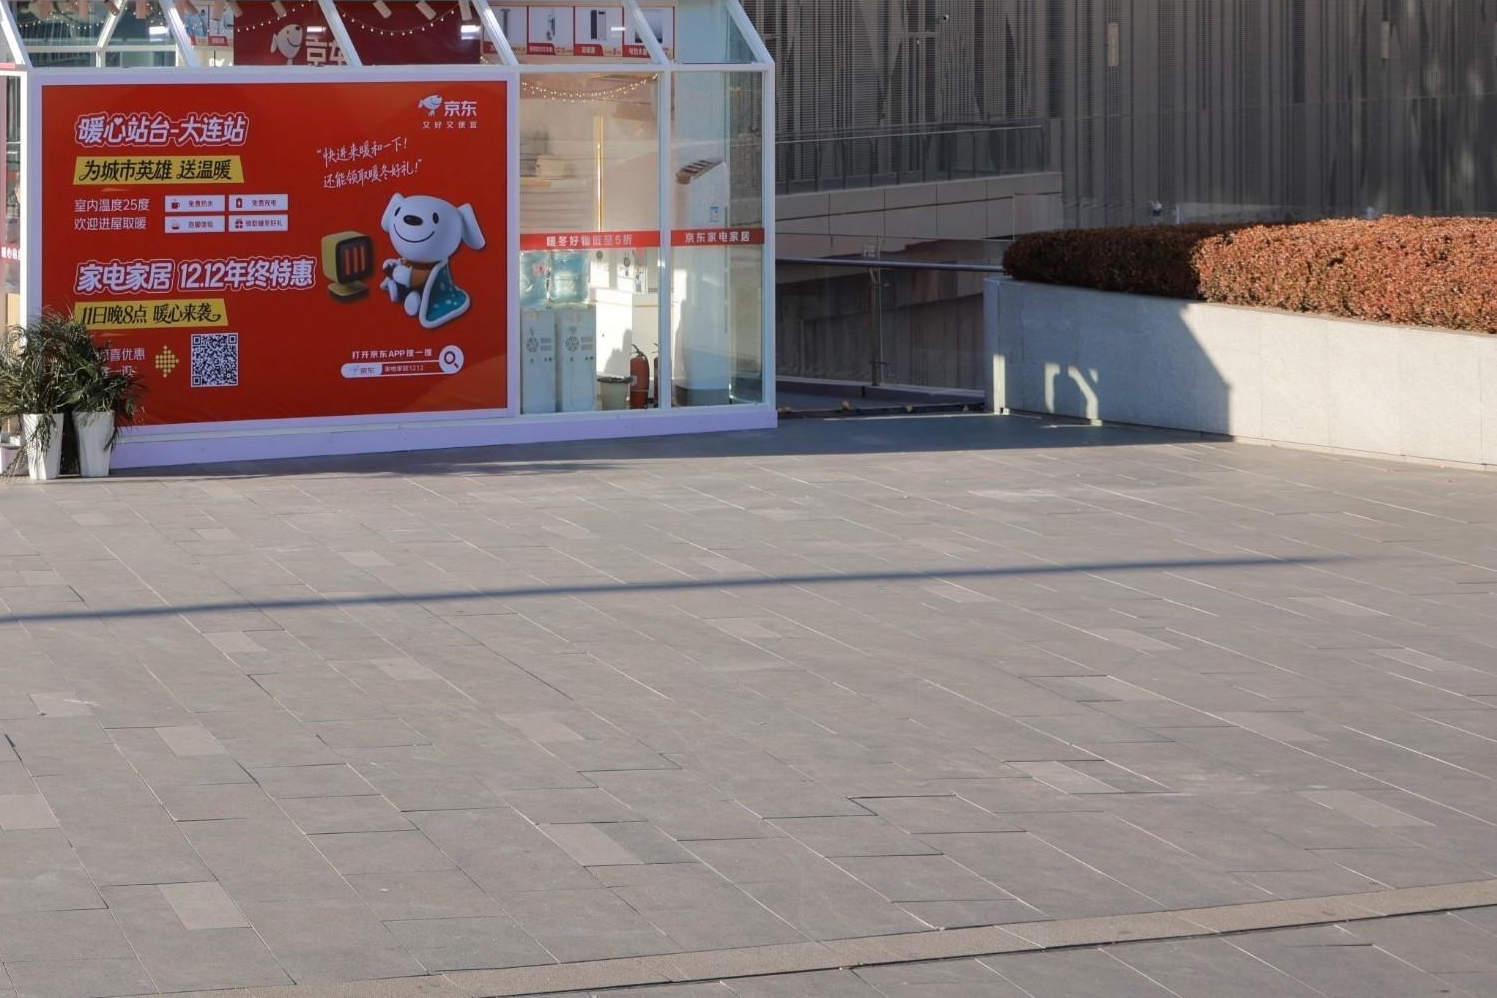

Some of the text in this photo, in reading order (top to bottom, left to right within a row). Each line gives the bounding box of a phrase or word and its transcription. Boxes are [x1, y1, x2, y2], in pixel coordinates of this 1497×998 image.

[443, 100, 478, 117] 京东
[76, 113, 248, 146] 暖心站台-大连站
[422, 121, 478, 129] 又好又便宜
[79, 158, 232, 182] 为城市英雄 送温暖
[74, 198, 151, 212] 室内温度25度
[74, 217, 147, 231] 欢迎进屋取暖
[685, 230, 751, 243] 京东家电家居
[75, 257, 316, 293] 家电家居 12.12年终特惠
[81, 303, 221, 325] 11日晚8点 暖心来袭
[352, 348, 432, 360] 打开京东APP搜一搜
